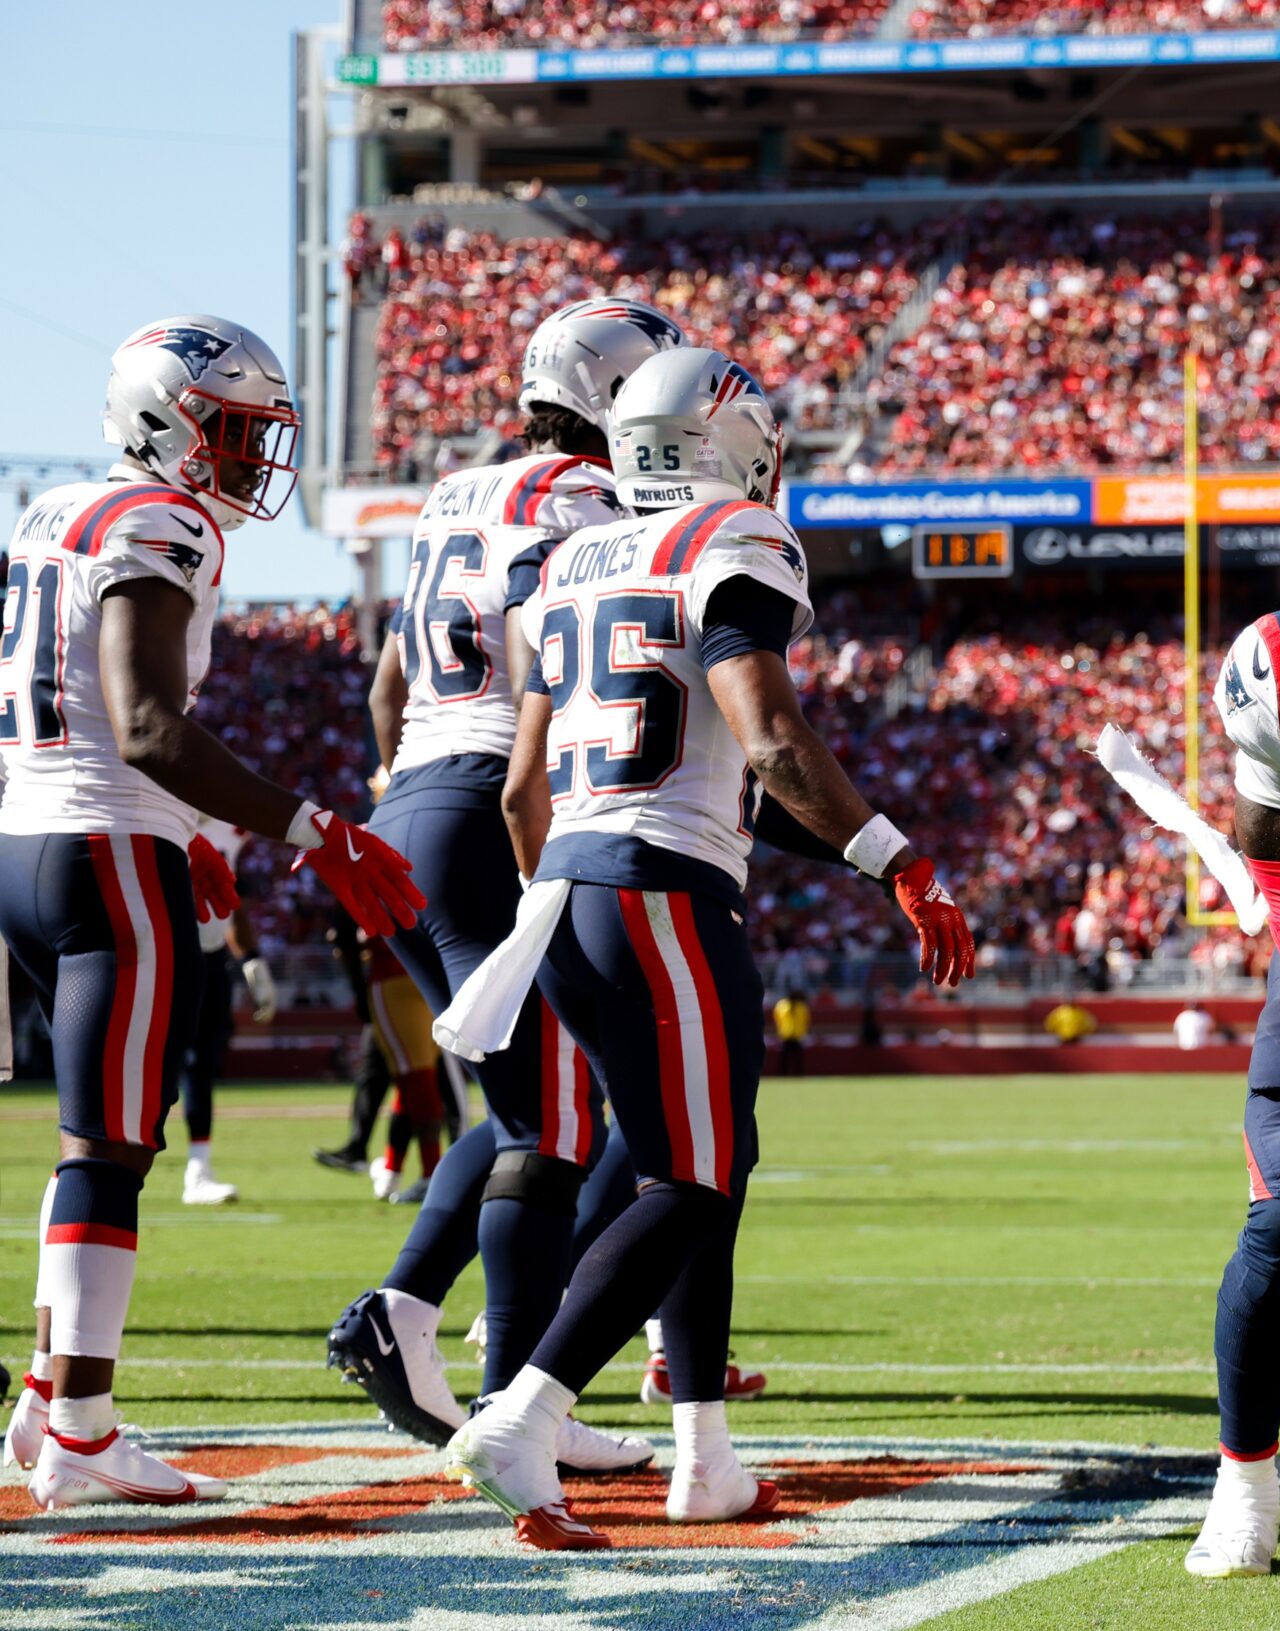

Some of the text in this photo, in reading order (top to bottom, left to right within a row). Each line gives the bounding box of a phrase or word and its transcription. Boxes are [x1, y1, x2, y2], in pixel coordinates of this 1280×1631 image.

[636, 445, 681, 471] 25
[634, 485, 694, 501] PATRIOTS
[556, 526, 648, 587] JONES
[540, 588, 690, 805] 25
